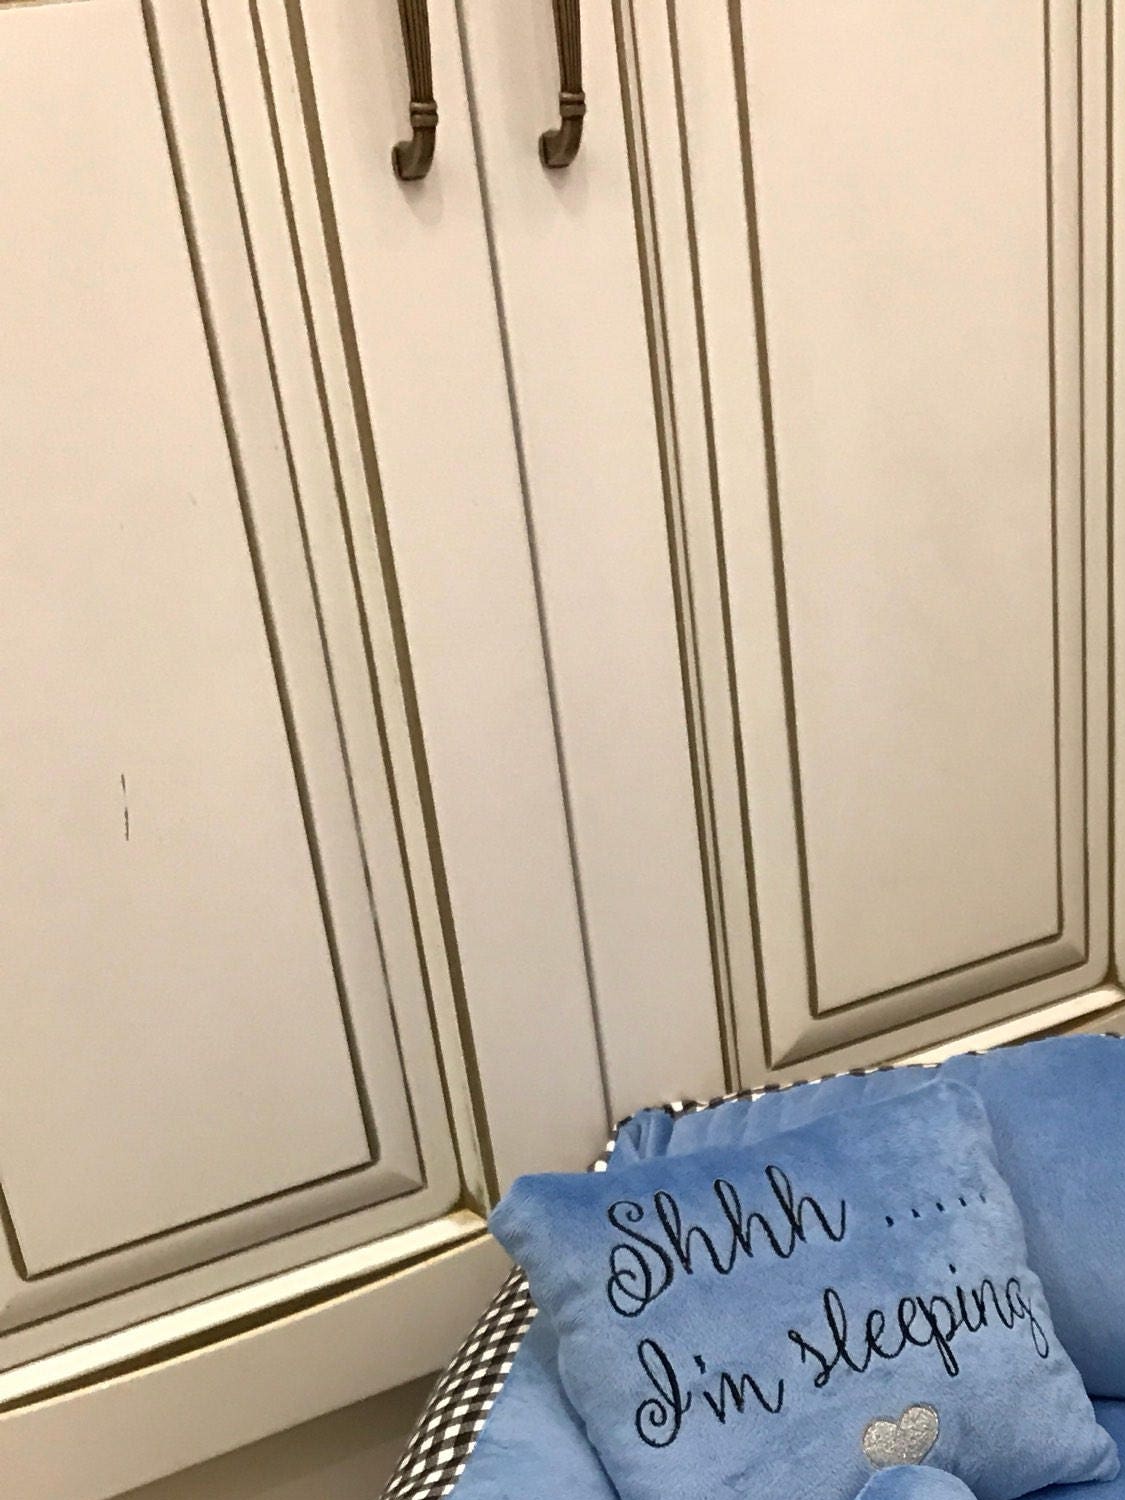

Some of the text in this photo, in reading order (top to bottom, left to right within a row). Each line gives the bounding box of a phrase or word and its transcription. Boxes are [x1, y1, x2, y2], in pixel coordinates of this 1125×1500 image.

[607, 1164, 846, 1318] Shhh
[635, 1263, 1050, 1448] I'm sleeping
